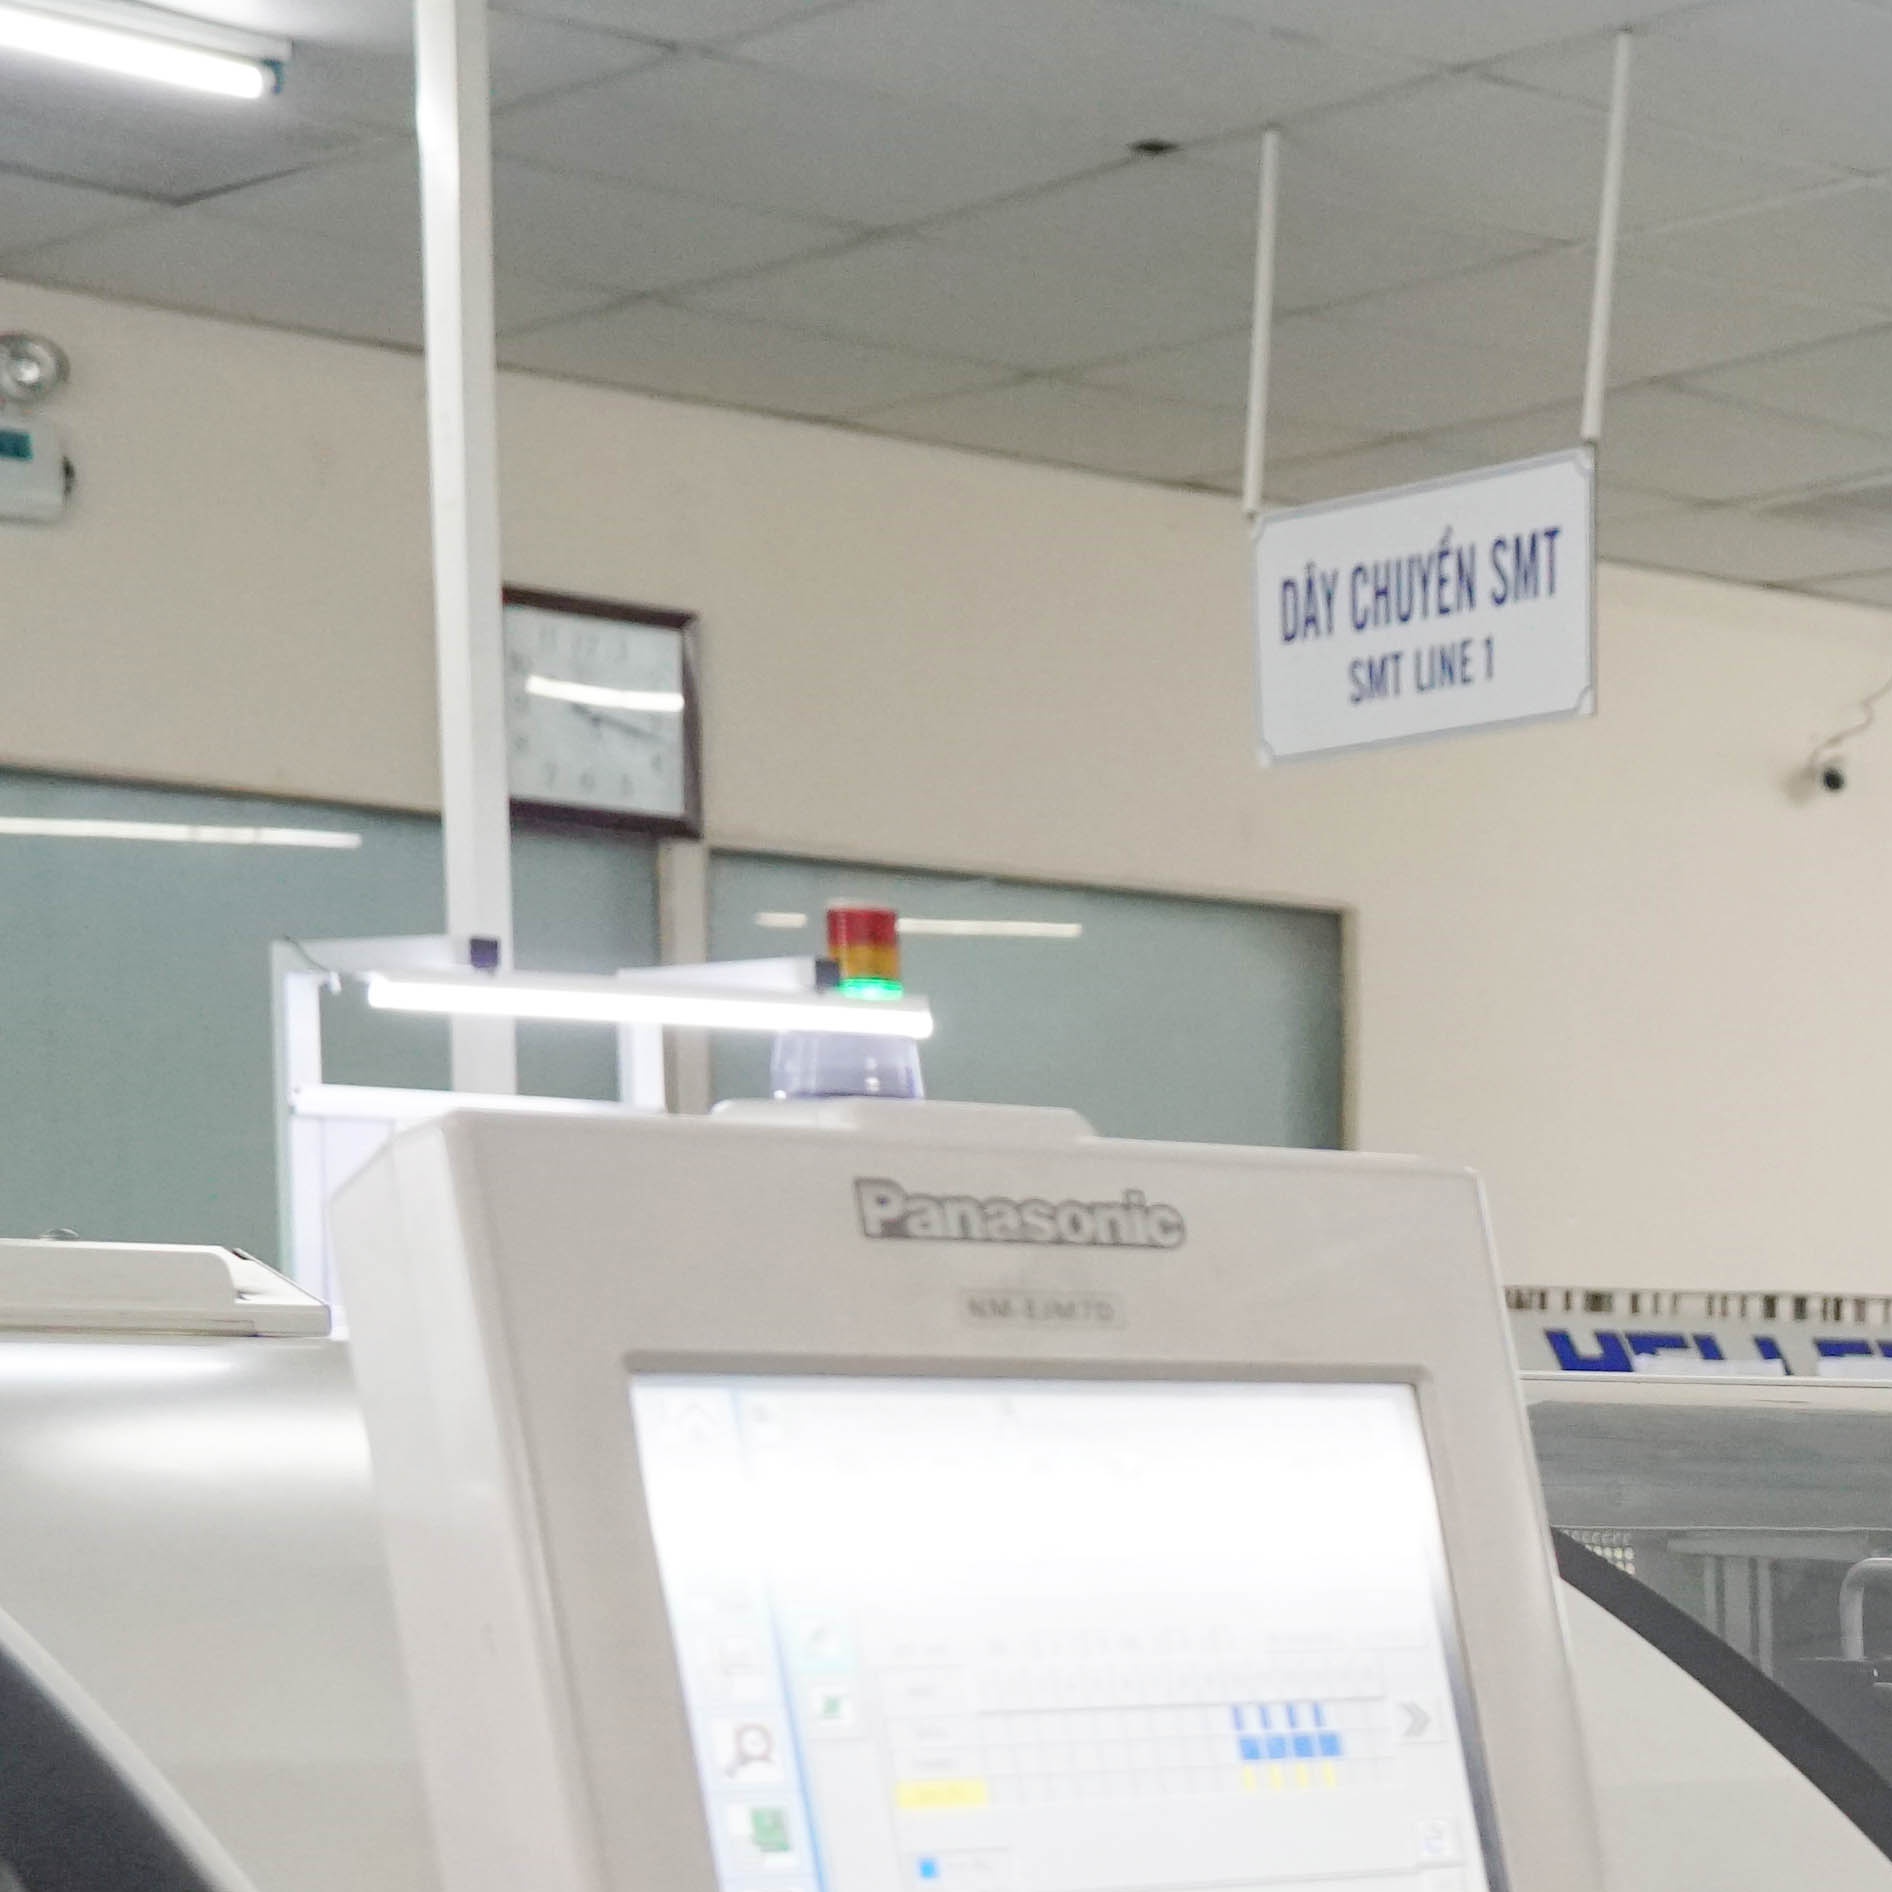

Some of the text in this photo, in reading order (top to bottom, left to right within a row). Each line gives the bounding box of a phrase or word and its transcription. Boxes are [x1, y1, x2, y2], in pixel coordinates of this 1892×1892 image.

[1281, 560, 1338, 643] DÂY
[1490, 526, 1561, 607] SMT
[1349, 636, 1495, 704] SMT LINE 1
[853, 1176, 1186, 1249] Panasonic
